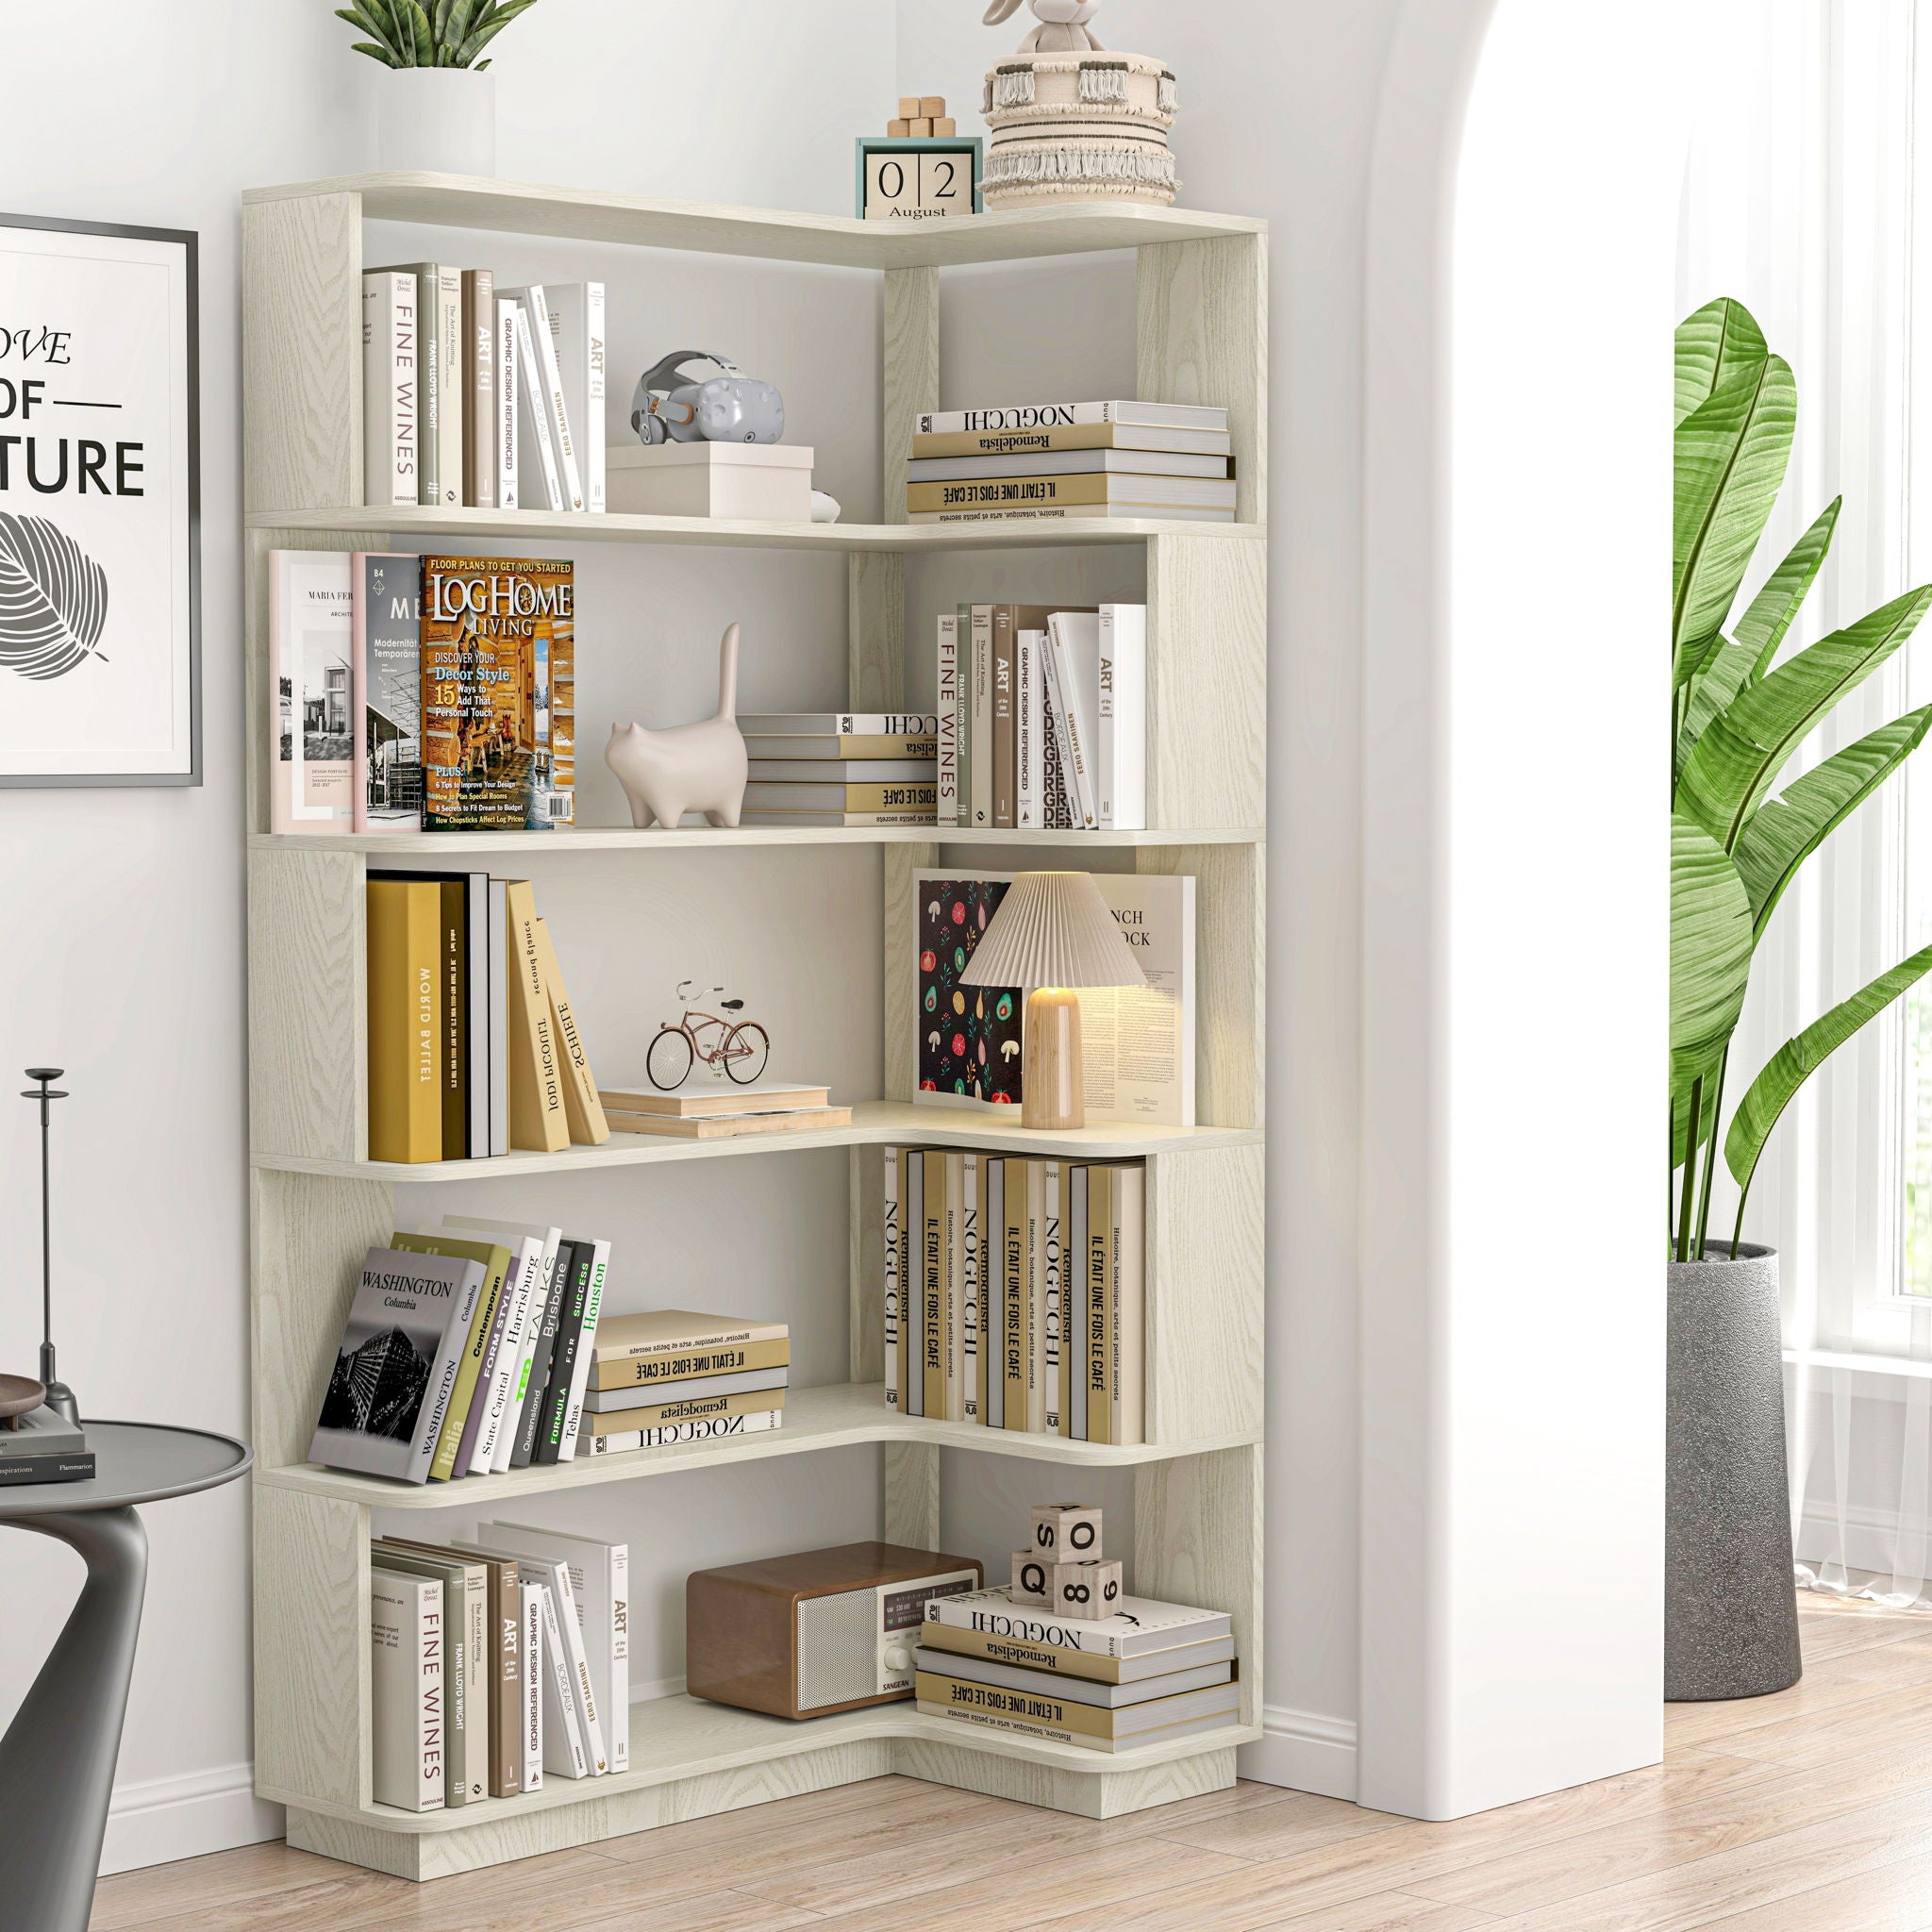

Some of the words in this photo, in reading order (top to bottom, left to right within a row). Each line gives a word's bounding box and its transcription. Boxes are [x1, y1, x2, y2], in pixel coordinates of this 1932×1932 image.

[889, 207, 946, 220] August
[396, 306, 413, 367] FINE
[478, 326, 492, 364] ART
[505, 318, 513, 362] GRAPHIC
[591, 337, 603, 374] ART
[505, 366, 513, 401] DESIGN
[396, 382, 414, 475] WINES
[963, 406, 1075, 431] NOGUCHI
[505, 406, 514, 470] REFERENCED
[979, 435, 1050, 452] Remodelista
[943, 488, 965, 506] CAFÉ
[968, 486, 977, 502] LE
[980, 485, 999, 501] FOIS
[1001, 485, 1019, 500] UNE
[1021, 482, 1045, 502] ÉTAIT
[1049, 482, 1056, 498] IL
[962, 512, 981, 521] petits
[374, 569, 384, 577] B4
[430, 559, 457, 570] FLOOR
[459, 560, 486, 571] PLANS
[488, 561, 498, 571] TO
[500, 562, 515, 571] GET
[518, 562, 534, 573] YOU
[537, 563, 571, 574] STARTED
[308, 591, 335, 601] MARIA
[474, 619, 532, 636] LIVING
[375, 639, 417, 648] Modernität
[435, 652, 473, 663] DISCOVER
[475, 652, 495, 663] YOUR
[435, 667, 474, 680] Decor
[475, 667, 510, 685] Style
[941, 644, 955, 701] FINE
[997, 658, 1009, 693] ART
[1100, 658, 1112, 693] ART
[435, 684, 455, 705] 15
[457, 683, 476, 695] Ways
[478, 684, 487, 693] to
[457, 696, 472, 706] Add
[474, 696, 491, 706] That
[435, 708, 469, 717] Personal
[471, 708, 493, 717] Touch
[1054, 712, 1069, 762] BORDEAUX
[1067, 713, 1079, 752] SAARINEN
[941, 713, 955, 798] WINES
[1075, 755, 1084, 774] EERO
[435, 767, 464, 777] PLUS:
[927, 1218, 939, 1229] IL
[1008, 1227, 1020, 1238] IL
[927, 1232, 941, 1265] ÉTAIT
[1091, 1236, 1104, 1246] IL
[1008, 1241, 1022, 1274] ÉTAIT
[1091, 1250, 1106, 1284] ÉTAIT
[886, 1199, 898, 1344] NOGUCHI
[927, 1267, 939, 1292] UNE
[964, 1208, 977, 1355] NOGUCHI
[362, 1271, 453, 1298] WASHINGTON
[1008, 1276, 1020, 1301] UNE
[1046, 1216, 1059, 1367] NOGUCHI
[384, 1296, 416, 1310] Columbia
[927, 1293, 939, 1320] FOIS
[1091, 1287, 1104, 1311] UNE
[484, 1333, 501, 1378] FORM
[496, 1280, 514, 1330] STYLE
[1008, 1304, 1020, 1329] FOIS
[1091, 1313, 1104, 1340] FOIS
[927, 1322, 939, 1337] LE
[1008, 1332, 1020, 1347] LE
[482, 1422, 497, 1456] State
[491, 1372, 509, 1418] Capital
[507, 1256, 539, 1344] Harrisburg
[524, 1390, 541, 1452] Queensland
[543, 1263, 566, 1338] Brisbane
[551, 1388, 567, 1444] FORMULA
[566, 1338, 575, 1363] FOR
[574, 1262, 589, 1317] SUCCESS
[566, 1405, 580, 1440] Tehas
[583, 1263, 606, 1330] Houston
[927, 1339, 941, 1369] CAFÉ
[1091, 1343, 1104, 1357] LE
[423, 1359, 457, 1455] WASHINGTON
[461, 1285, 477, 1322] Columbia
[438, 1421, 464, 1466] Italia
[473, 1275, 501, 1357] Contemporan
[1008, 1349, 1022, 1380] CAFÉ
[1091, 1360, 1106, 1391] CAFÉ
[1038, 1524, 1054, 1547] S
[1021, 1563, 1045, 1596] Q
[1063, 1584, 1090, 1603] 8
[614, 1600, 626, 1634] ART
[504, 1619, 517, 1654] ART
[972, 1611, 1082, 1650] NOGUCHI
[424, 1614, 439, 1675] FINE
[987, 1642, 1057, 1668] Remodelista
[456, 1671, 464, 1696] LLOYD
[558, 1663, 573, 1714] BORDEAUX
[578, 1661, 591, 1701] SAARINEN
[883, 1679, 909, 1690] SANGEAN
[952, 1685, 973, 1703] CAFÉ
[975, 1689, 985, 1706] LE
[988, 1691, 1007, 1709] FOIS
[1008, 1696, 1025, 1713] UNE
[456, 1698, 464, 1730] WRIGHT
[586, 1703, 595, 1723] EERO
[948, 1710, 970, 1720] secrets
[971, 1714, 988, 1724] petits
[1027, 1700, 1052, 1722] ÉTAIT
[1054, 1704, 1061, 1721] IL
[424, 1687, 440, 1779] WINES
[422, 1797, 443, 1807] ASSOULINE
